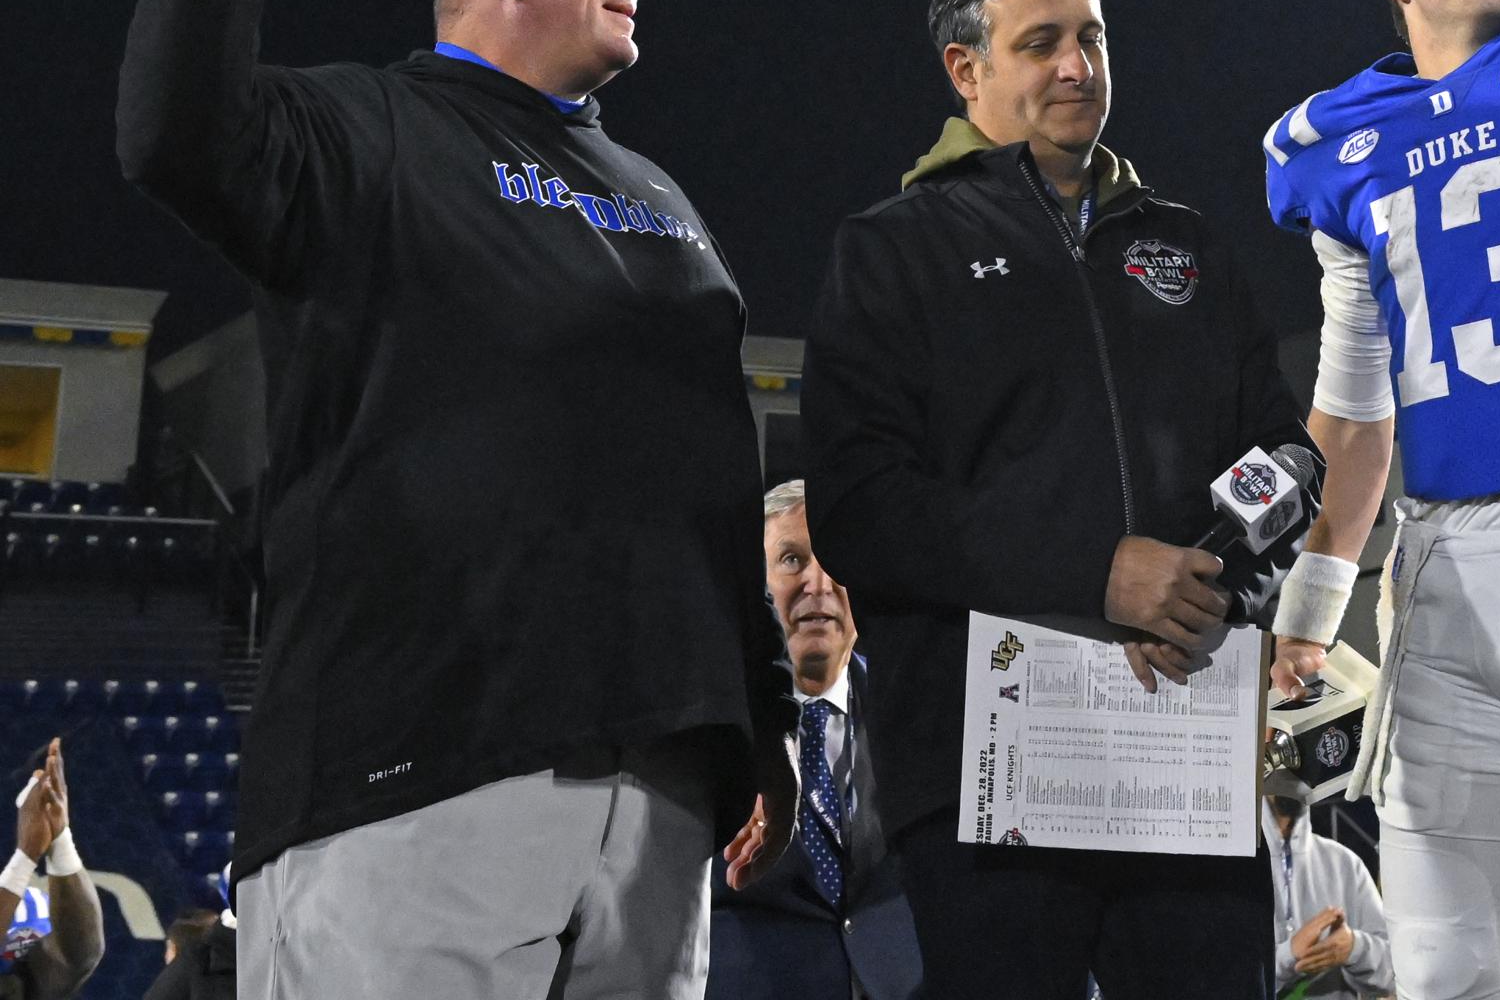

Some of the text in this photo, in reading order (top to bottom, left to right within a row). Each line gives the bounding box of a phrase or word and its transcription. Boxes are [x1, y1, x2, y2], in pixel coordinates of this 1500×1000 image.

[1345, 131, 1375, 158] ACC
[1405, 121, 1497, 177] DUKE
[1081, 199, 1090, 235] MILITAR
[1128, 255, 1191, 268] MILITARY
[1145, 267, 1185, 279] BOWL
[1240, 464, 1276, 497] MILITARY
[1240, 476, 1262, 498] BOWL
[991, 630, 1024, 671] UCF
[990, 712, 998, 725] PM
[980, 749, 988, 775] 2022
[989, 742, 996, 756] MD
[368, 761, 413, 783] DRI-FIT
[1006, 744, 1015, 801] UCF KNIGHTS
[984, 813, 993, 845] TADIUM
